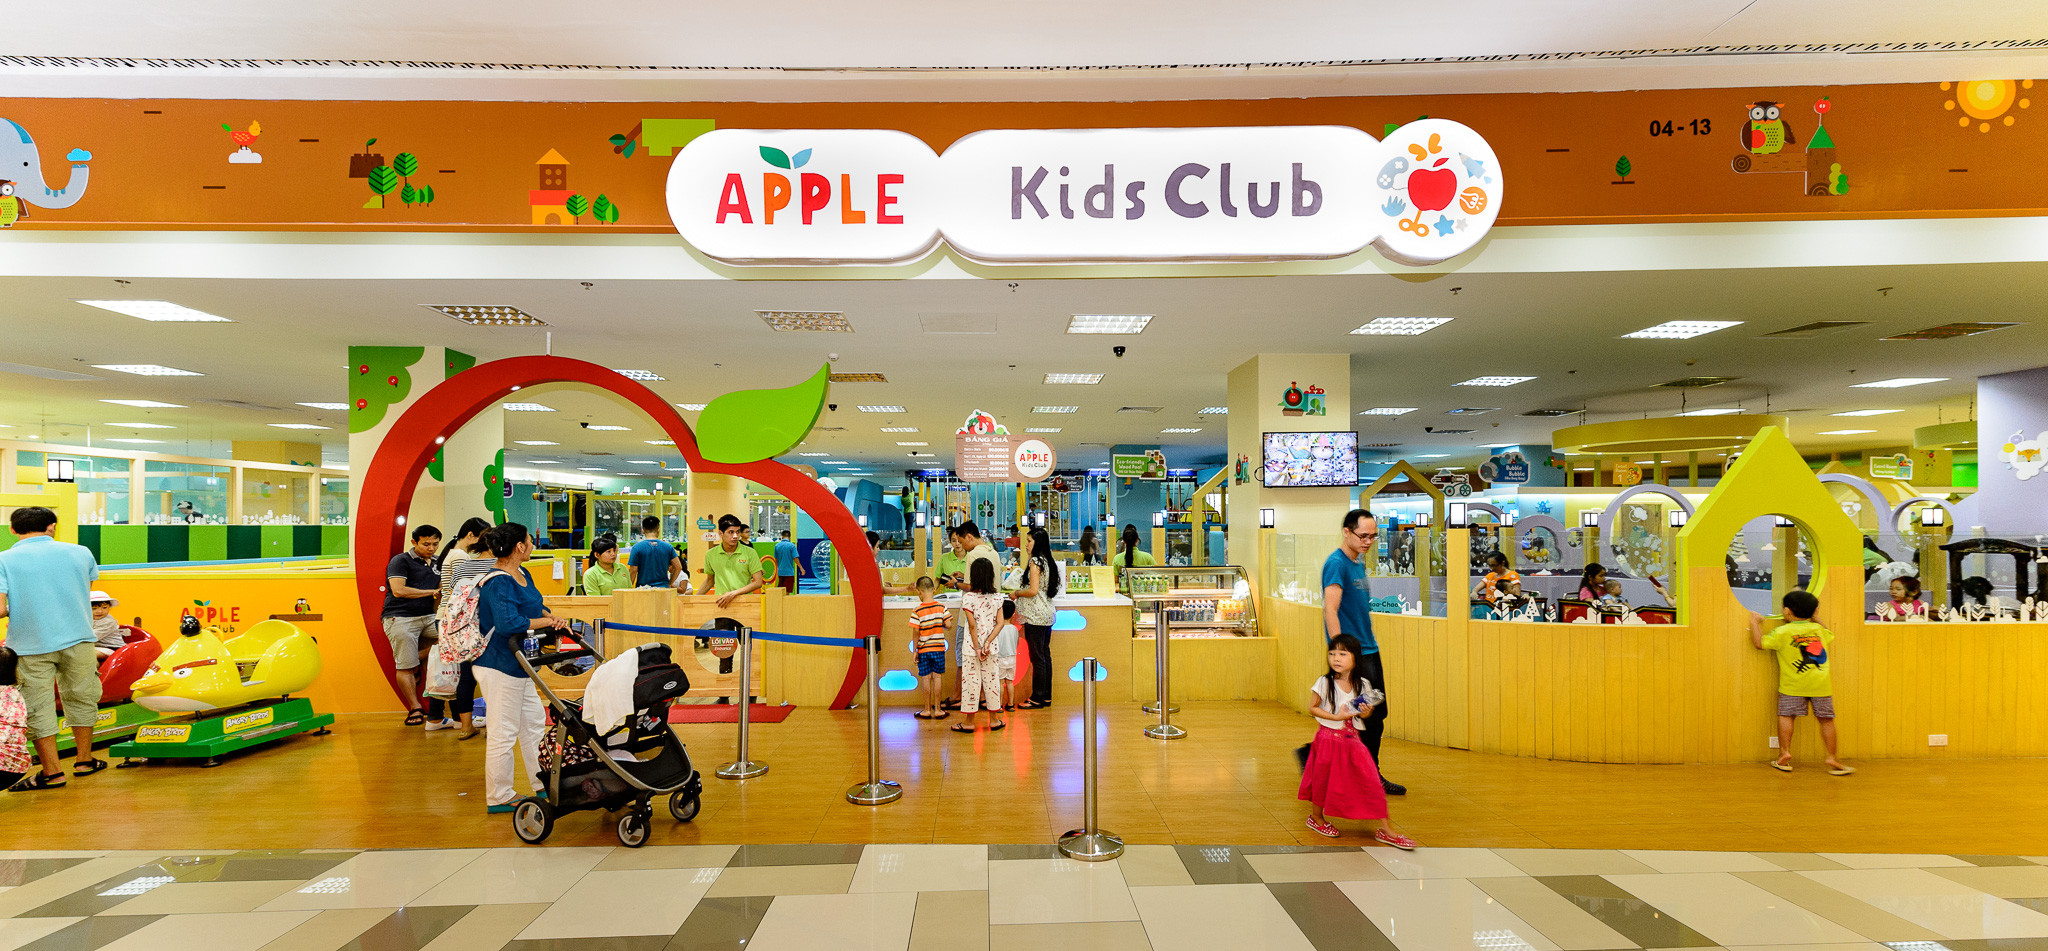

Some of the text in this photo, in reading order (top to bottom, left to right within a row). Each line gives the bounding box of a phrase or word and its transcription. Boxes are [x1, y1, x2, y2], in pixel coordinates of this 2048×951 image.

[716, 163, 1323, 225] APPLE Kids Club
[1019, 453, 1048, 462] APPLE
[180, 606, 240, 623] APPLE
[226, 709, 270, 728] ANGRY BIRDS
[139, 726, 187, 737] ANGRY BIRDS
